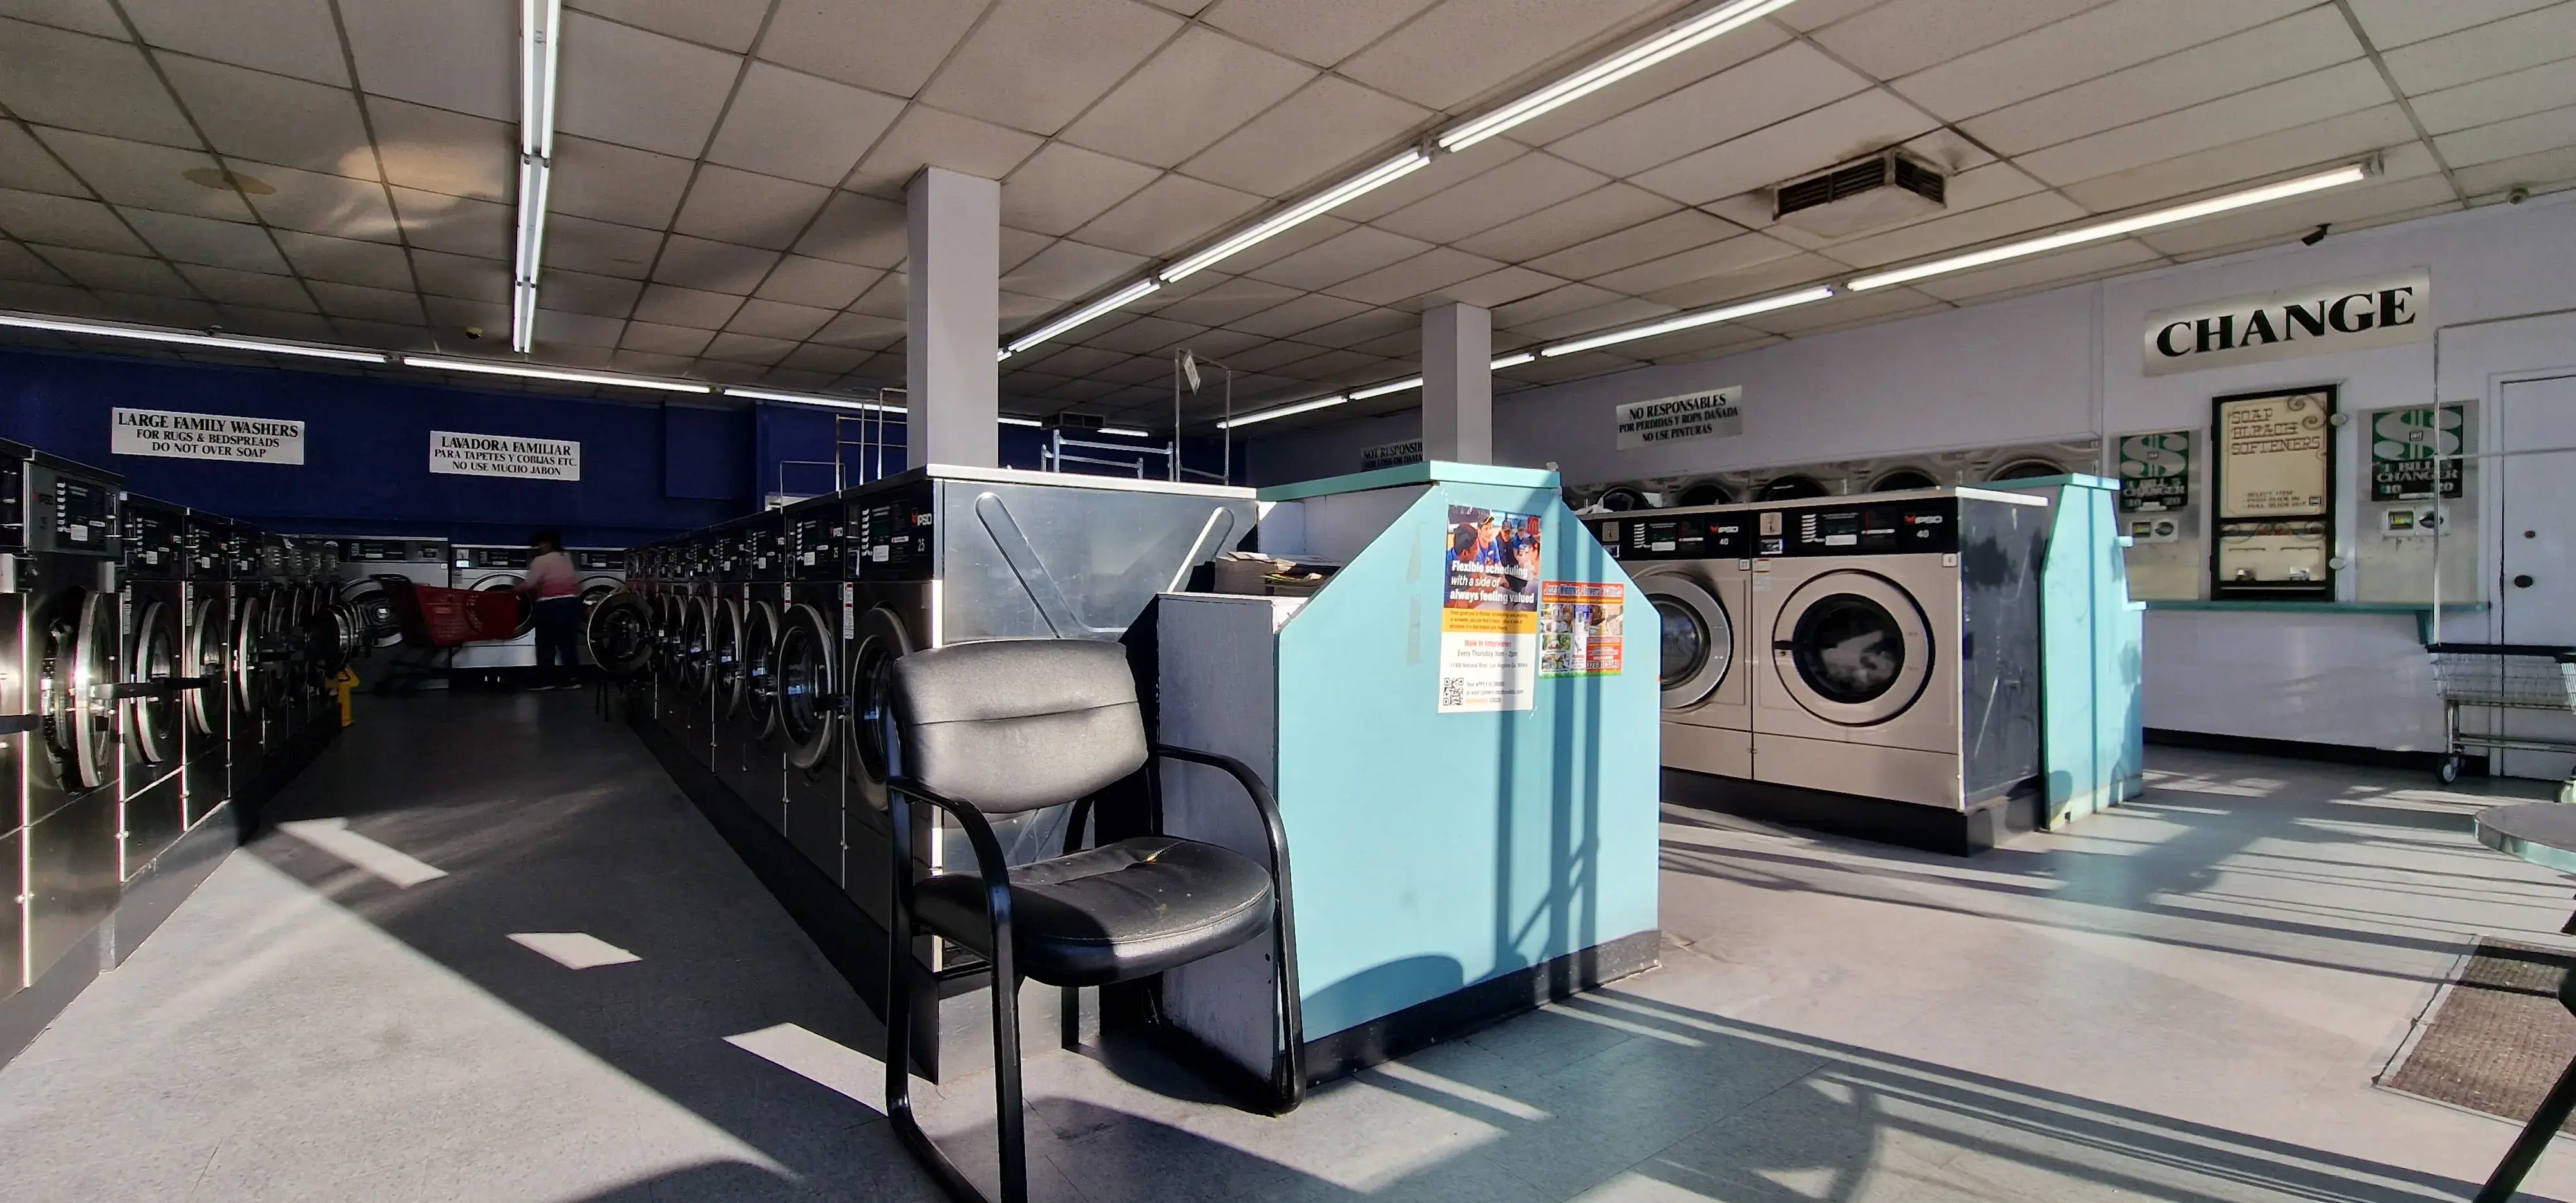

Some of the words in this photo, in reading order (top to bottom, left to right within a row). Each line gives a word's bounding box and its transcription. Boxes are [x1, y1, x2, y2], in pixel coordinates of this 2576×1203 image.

[2156, 286, 2416, 357] CHANGE
[1629, 407, 1644, 421] NO
[1646, 393, 1727, 418] RESPONSABLES
[118, 412, 168, 428] LARGE
[173, 416, 226, 432] FAMILY
[231, 421, 298, 437] WASHERS
[1619, 423, 1634, 433] POR
[1636, 417, 1672, 431] PERDIDAS
[1674, 416, 1680, 424] Y
[1681, 413, 1702, 424] ROPA
[1704, 406, 1739, 420] DAÑADA
[2232, 408, 2273, 424] SOAP
[137, 429, 159, 439] FOR
[164, 431, 193, 442] RUGS
[196, 433, 205, 442] &
[209, 434, 280, 448] BEDSPREADS
[1643, 431, 1654, 442] NO
[1656, 430, 1669, 440] USE
[1671, 422, 1712, 439] PINTURAS
[2232, 421, 2298, 439] BLEACH
[152, 442, 170, 452] DO
[174, 444, 198, 453] NOT
[202, 446, 232, 456] OVER
[236, 448, 267, 458] SOAP
[441, 436, 509, 452] LAVADORA
[513, 442, 571, 456] FAMILIAR
[1363, 449, 1378, 459] NOT
[1380, 442, 1423, 457] RESPONSIB
[2231, 436, 2320, 455] SOFTENERS
[434, 449, 460, 459] PARA
[464, 451, 506, 462] TAPETES
[516, 454, 555, 465] COBIJAS
[558, 457, 577, 466] ETC.
[452, 460, 468, 470] NO
[470, 462, 488, 471] USE
[491, 463, 528, 474] MUCHO
[530, 466, 561, 475] JABON
[2123, 486, 2185, 497] CHANGER
[1917, 529, 1929, 538] 40
[918, 538, 925, 551] 25
[1452, 560, 1484, 573] Flexible
[1486, 565, 1528, 578] scheduling
[1451, 574, 1468, 586] with
[1475, 576, 1491, 587] side
[1492, 578, 1501, 587] of
[1450, 589, 1479, 603] always
[1480, 590, 1508, 604] feeling
[1510, 592, 1535, 603] valued
